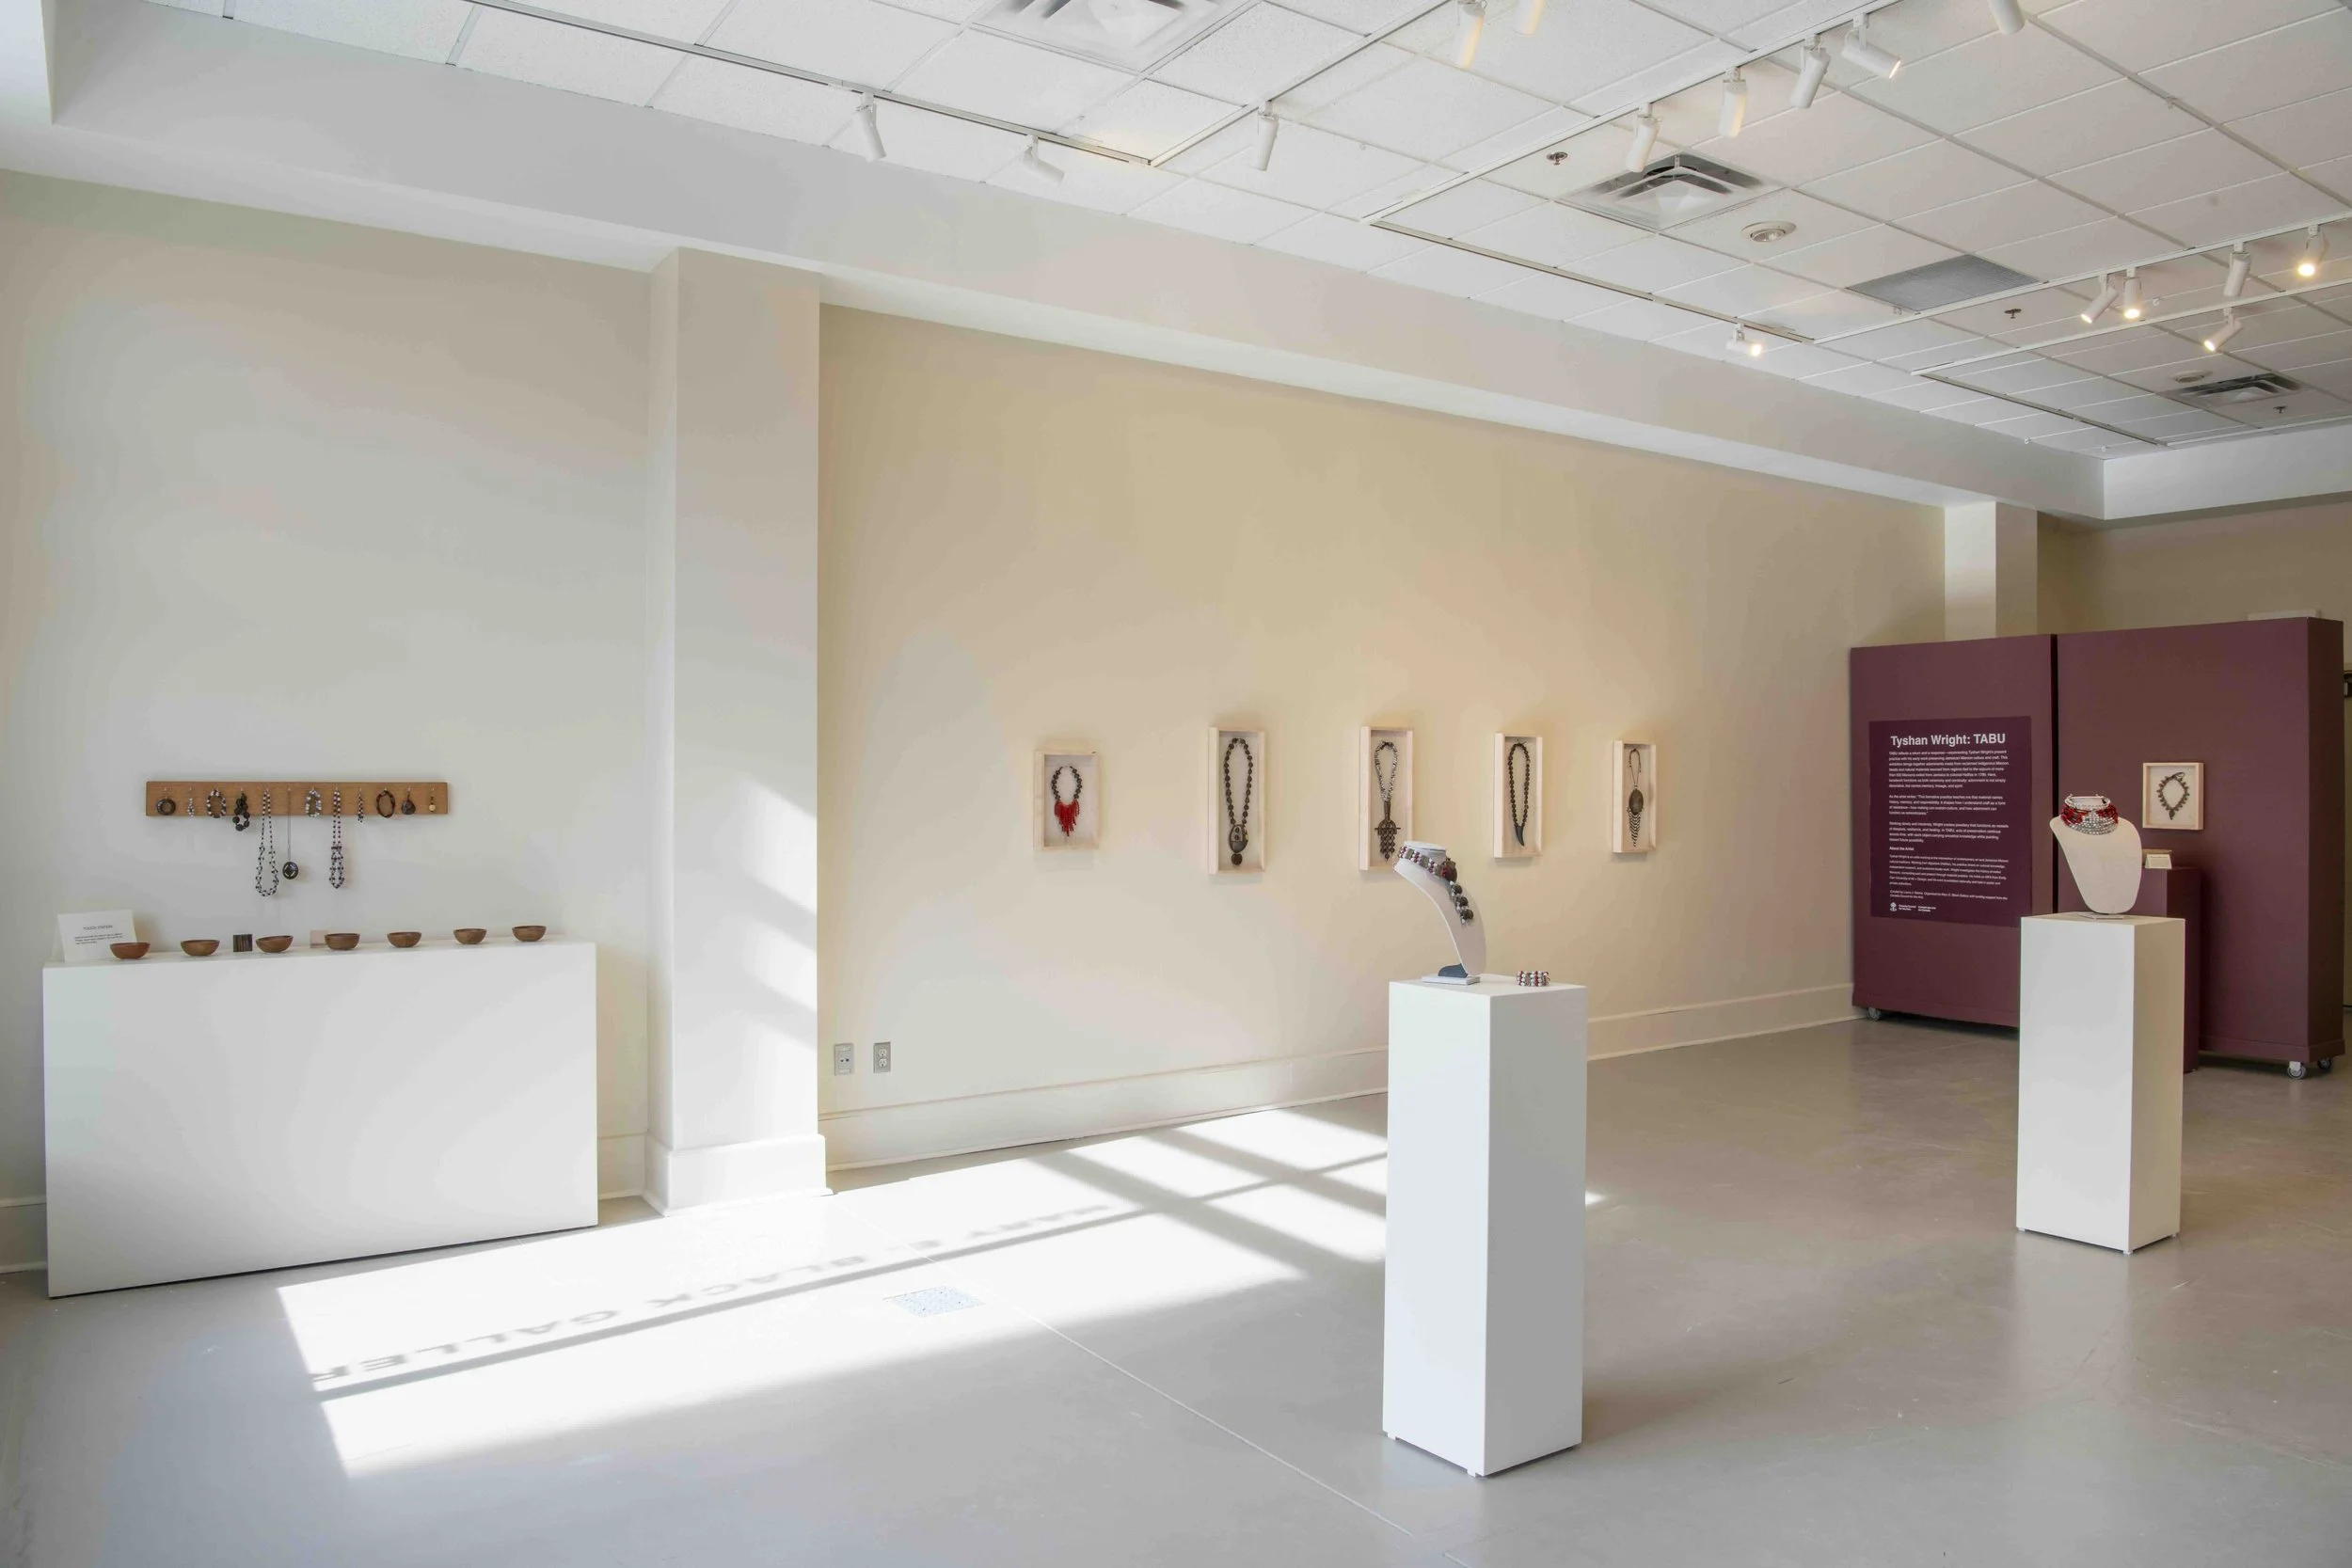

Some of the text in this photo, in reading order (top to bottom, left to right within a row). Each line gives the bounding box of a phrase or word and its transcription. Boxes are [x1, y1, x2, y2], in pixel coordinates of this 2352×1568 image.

[1890, 733, 2006, 748] Tyshan Wright: TABU
[647, 1255, 866, 1308] BLACK
